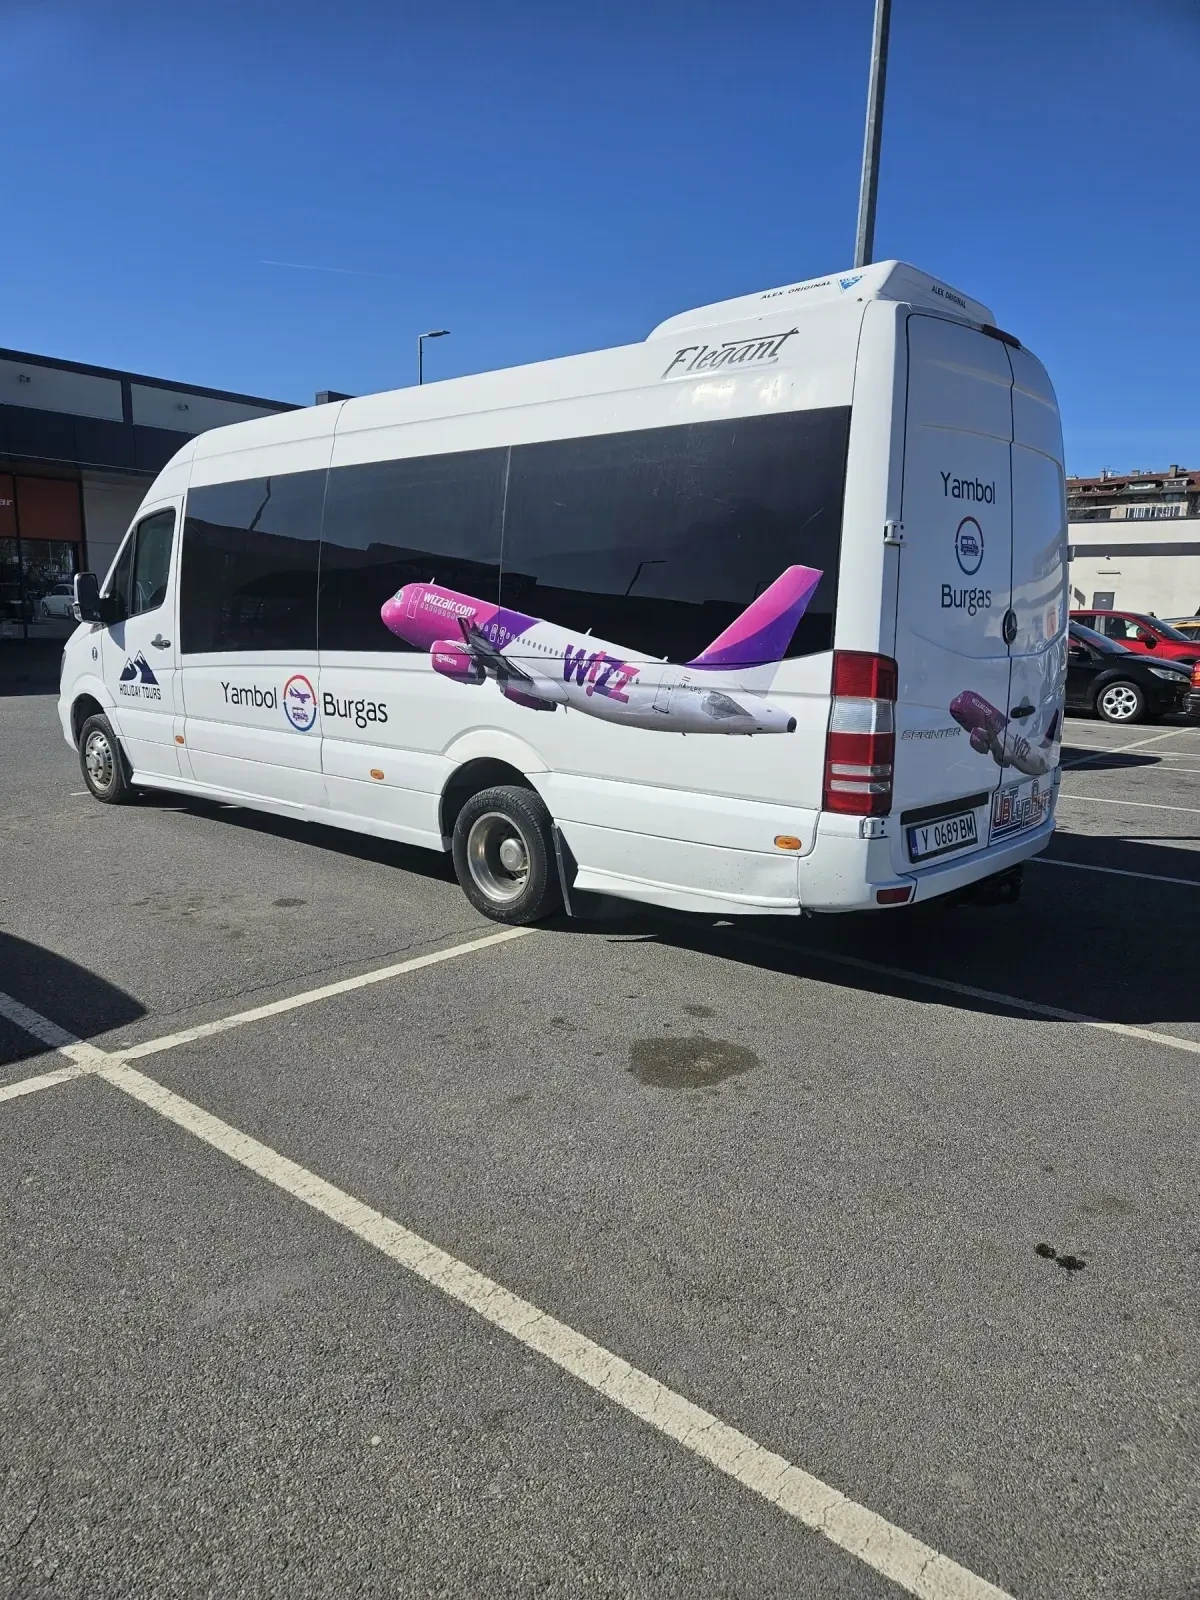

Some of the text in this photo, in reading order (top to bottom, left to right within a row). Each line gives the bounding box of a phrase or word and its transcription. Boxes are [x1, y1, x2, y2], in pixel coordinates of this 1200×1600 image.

[760, 280, 832, 300] ALEX ORIGINAL
[931, 285, 944, 297] ALEX
[940, 471, 996, 504] Yambol
[423, 591, 477, 618] wizzair.com
[940, 584, 992, 616] Burgas
[119, 683, 162, 701] HOLIDAY TOURS
[220, 681, 389, 729] Yambol Burgas
[900, 727, 962, 741] SPRINTER
